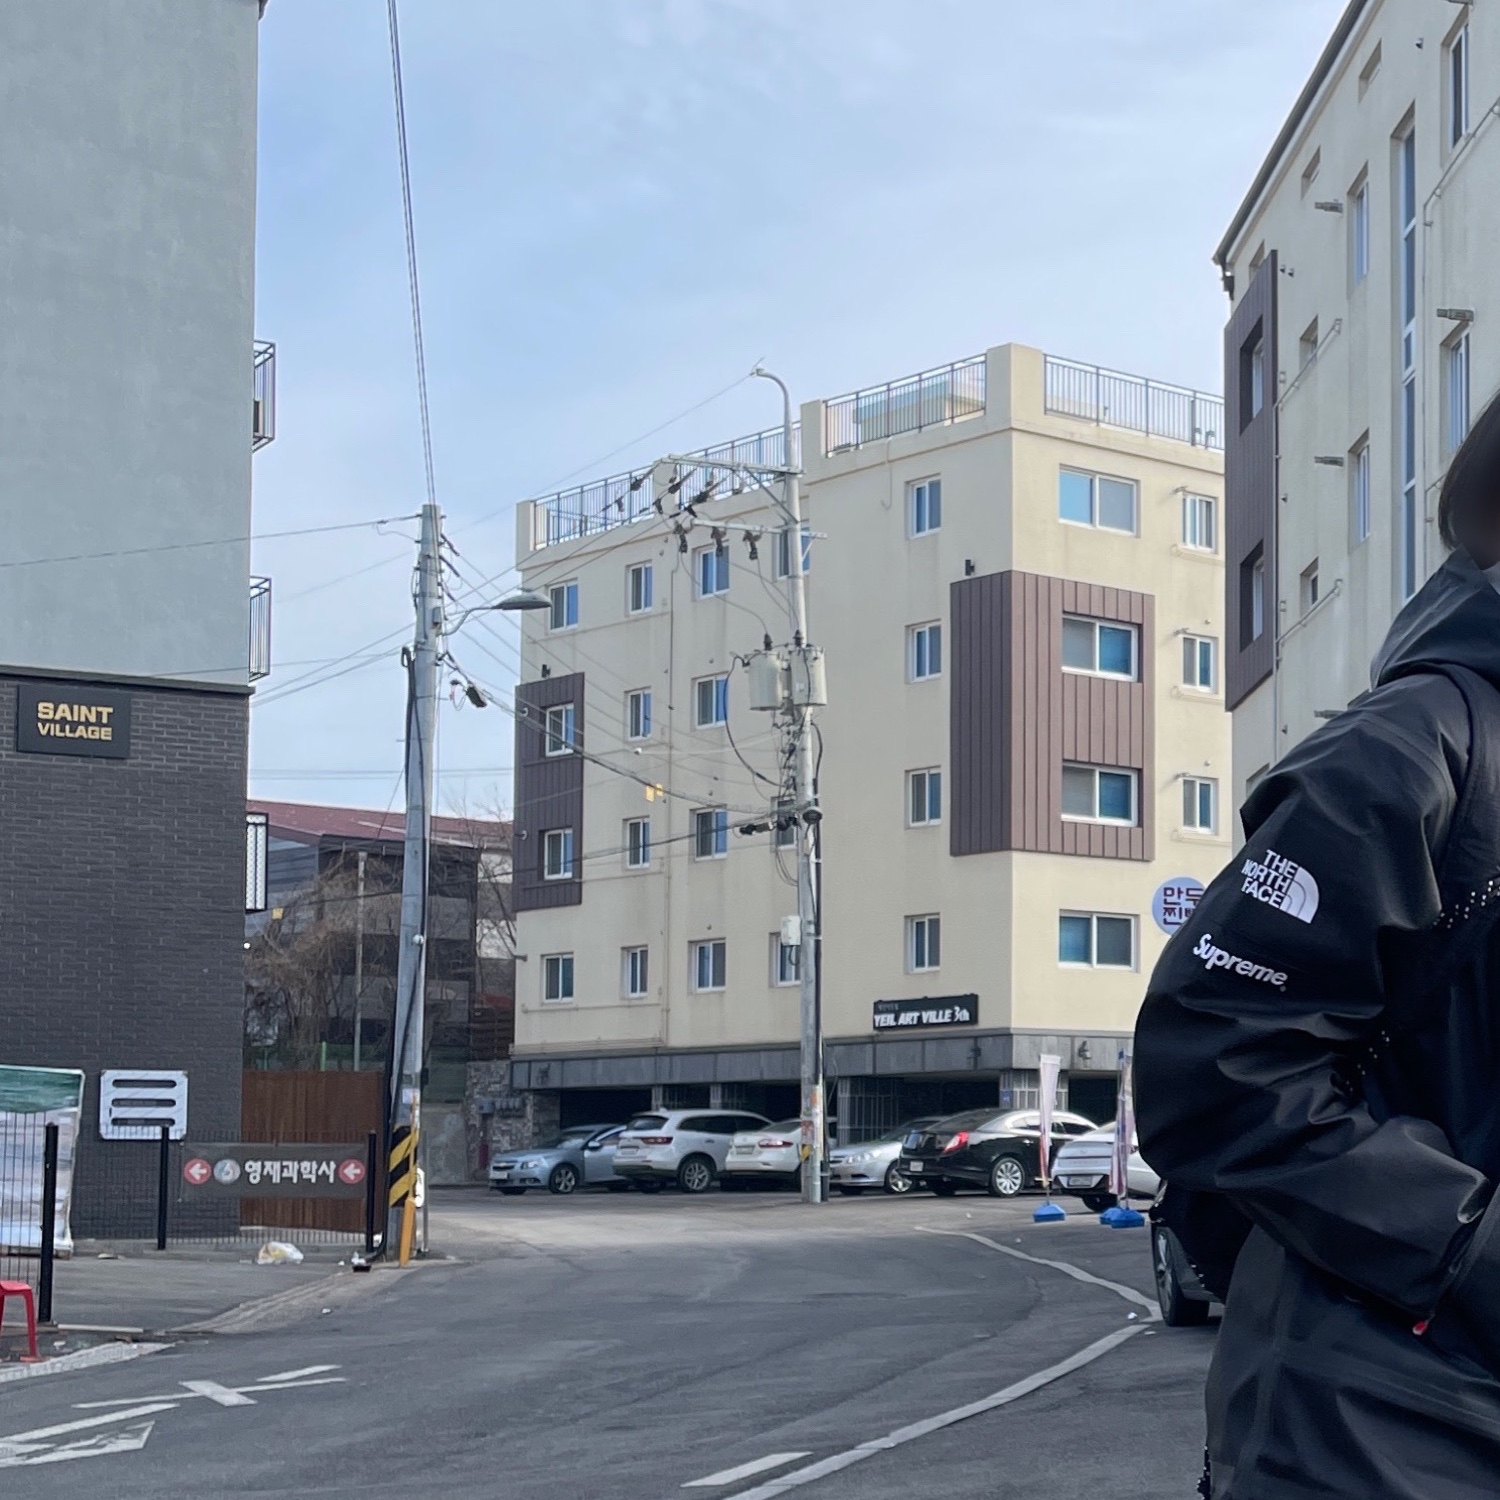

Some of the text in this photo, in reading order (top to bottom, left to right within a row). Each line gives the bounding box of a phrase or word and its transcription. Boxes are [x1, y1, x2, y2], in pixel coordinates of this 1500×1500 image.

[37, 702, 114, 724] SAINT
[37, 722, 113, 741] VILLAGE
[1241, 858, 1291, 895] NORTH
[1262, 849, 1300, 880] THE
[1241, 877, 1286, 910] FACE
[1192, 933, 1289, 986] Supreme
[874, 1013, 897, 1027] YEIL
[898, 1011, 920, 1026] ART
[921, 1008, 953, 1024] VILLE
[244, 1159, 338, 1185] 영재과학사
